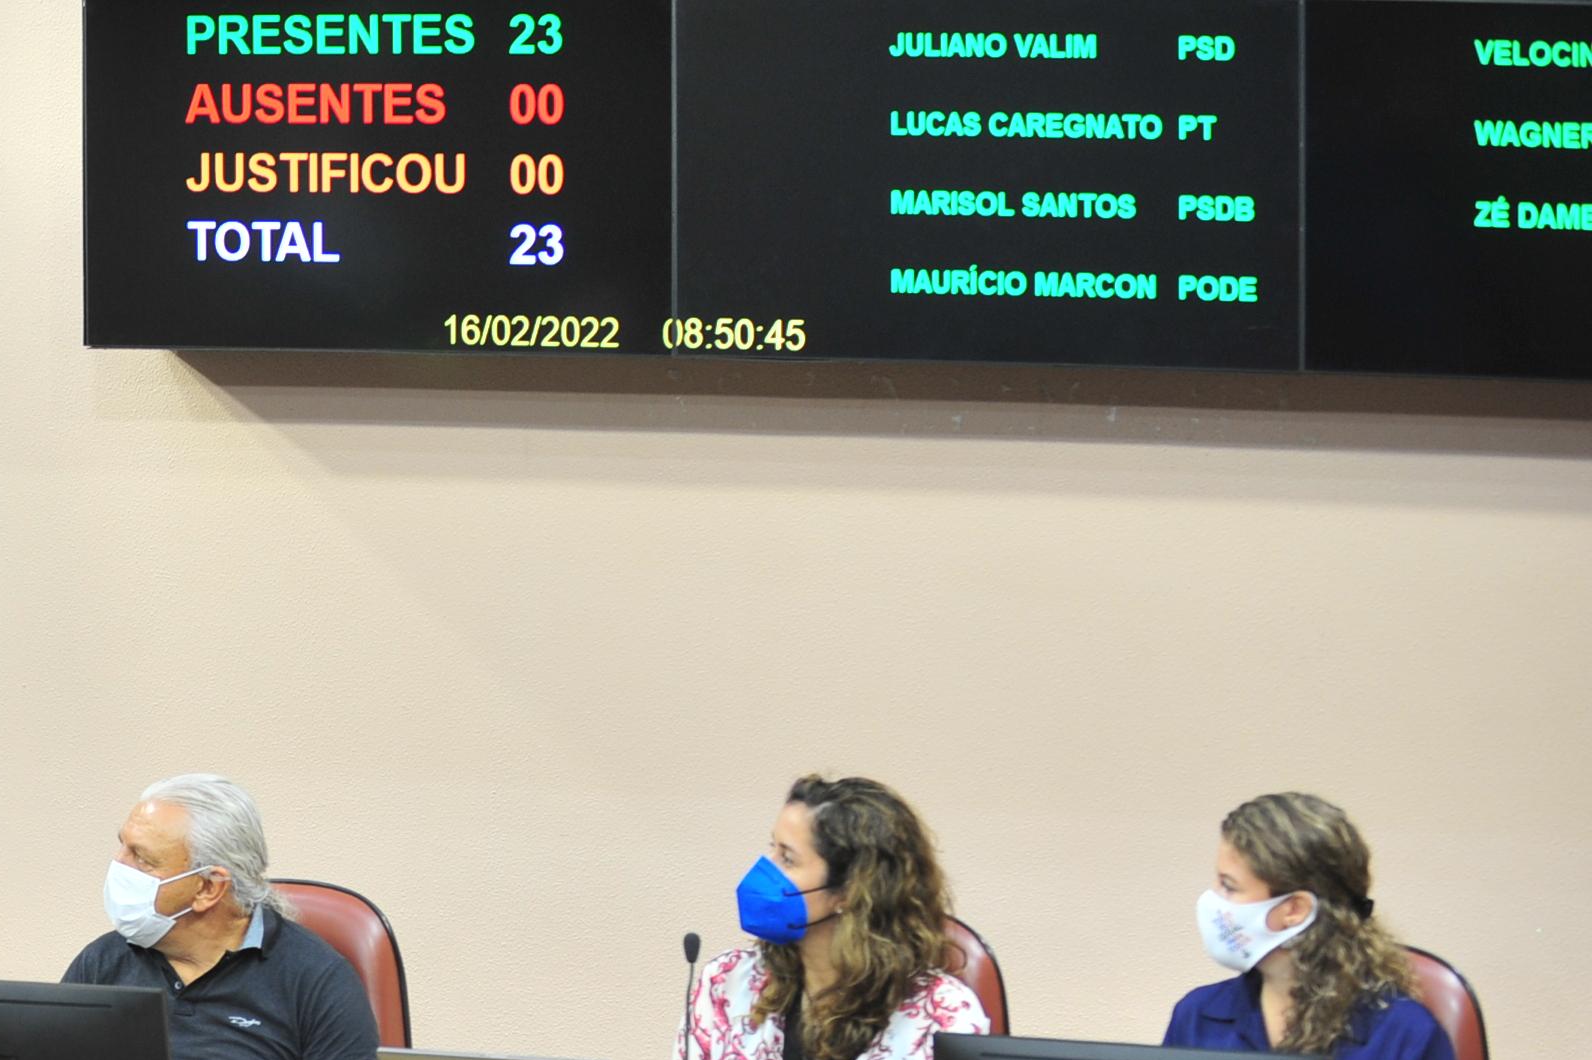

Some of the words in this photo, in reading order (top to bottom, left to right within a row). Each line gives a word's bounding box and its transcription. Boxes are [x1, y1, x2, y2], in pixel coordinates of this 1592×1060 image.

[187, 14, 475, 55] PRESENTES
[509, 13, 563, 54] 23
[889, 32, 1008, 58] JULIANO
[1013, 33, 1097, 59] VALIM
[1178, 35, 1235, 61] PSD
[185, 82, 446, 125] AUSENTES
[509, 83, 565, 125] 00
[890, 111, 982, 137] LUCAS
[988, 112, 1163, 140] CAREGNATO
[1178, 115, 1217, 140] PT
[186, 152, 466, 194] JUSTIFICOU
[510, 154, 564, 195] 00
[890, 189, 1015, 217] MARISOL
[1022, 192, 1136, 219] SANTOS
[1178, 195, 1255, 222] PSDB
[1474, 195, 1510, 228] ZÉ
[186, 219, 341, 263] TOTAL
[509, 221, 566, 266] 23
[891, 264, 1027, 296] MAURÍCIO
[1034, 271, 1157, 299] MARCON
[1178, 275, 1258, 302] PODE
[444, 314, 619, 348] 16/02/2022
[663, 317, 805, 351] 08:50:45
